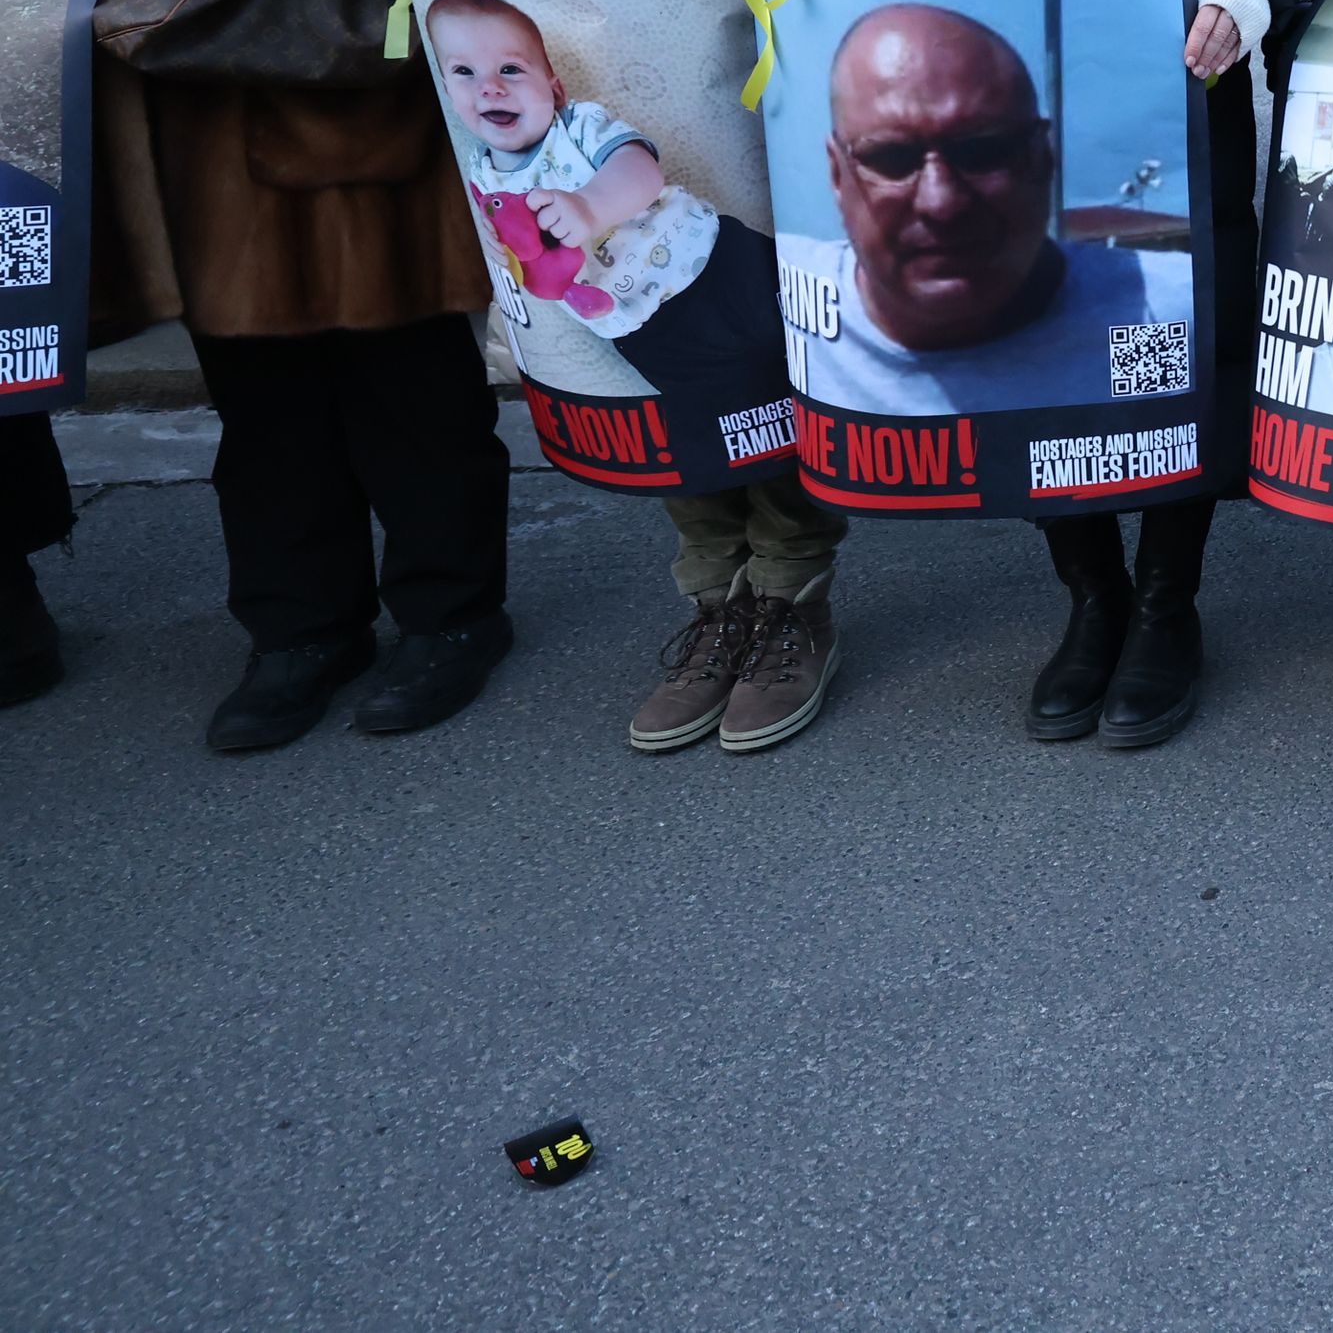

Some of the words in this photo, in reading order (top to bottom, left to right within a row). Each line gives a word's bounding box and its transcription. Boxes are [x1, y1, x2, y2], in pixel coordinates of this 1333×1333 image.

[778, 257, 838, 340] RING
[1255, 331, 1315, 409] HIM
[559, 400, 673, 465] NOW!
[718, 397, 793, 435] HOSTAGES
[724, 417, 797, 462] FAMILI
[793, 397, 837, 477] ME
[845, 418, 979, 486] NOW!
[1029, 435, 1101, 463] HOSTAGES
[1104, 431, 1133, 456] AND
[1136, 422, 1197, 452] MISSING
[1030, 454, 1123, 490] FAMILIES
[1128, 443, 1198, 480] FORUM
